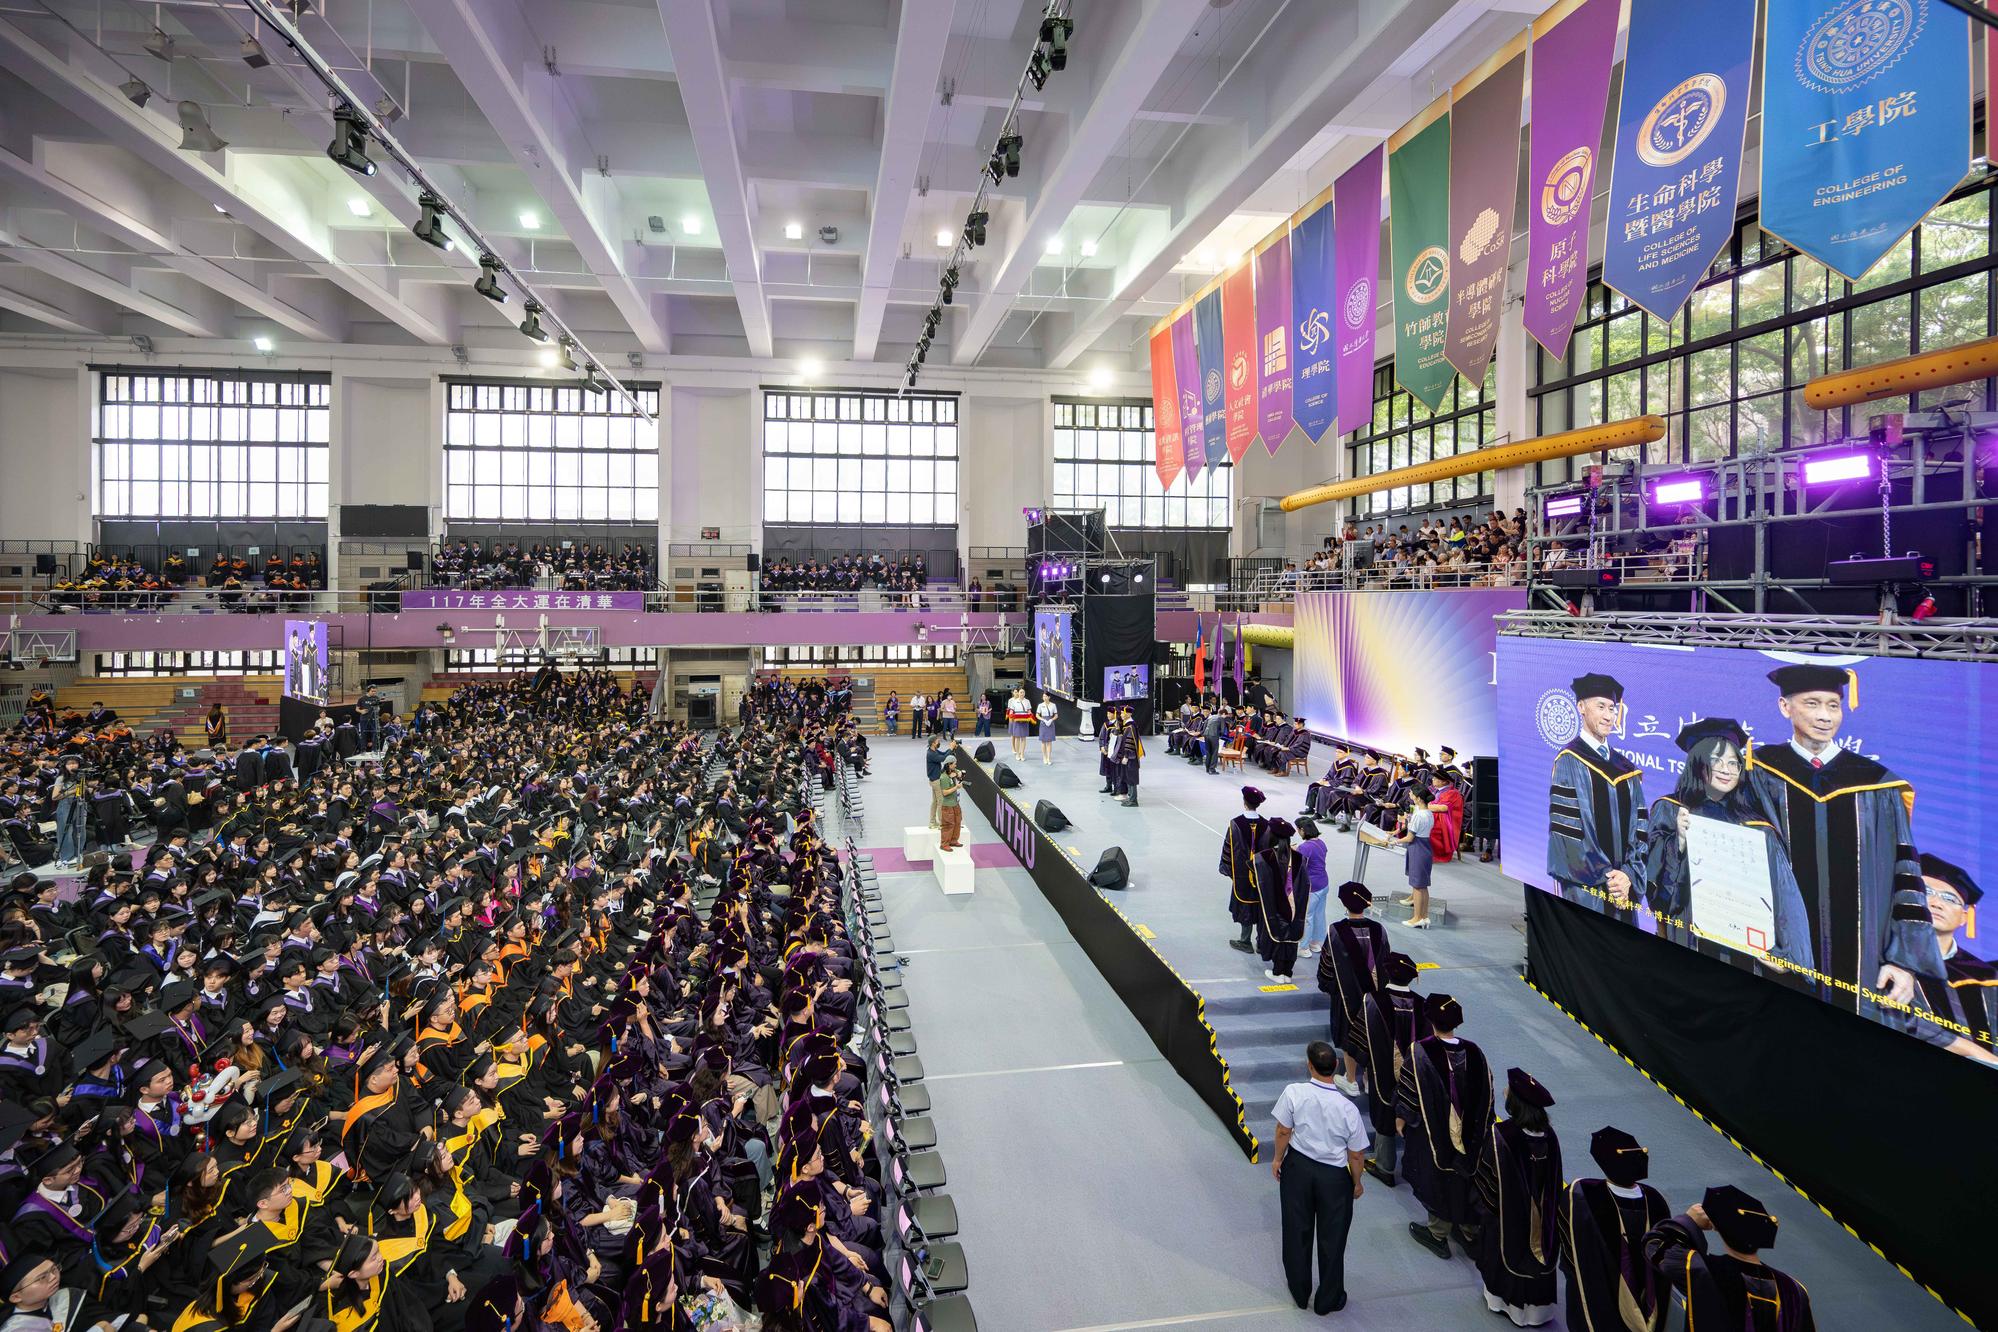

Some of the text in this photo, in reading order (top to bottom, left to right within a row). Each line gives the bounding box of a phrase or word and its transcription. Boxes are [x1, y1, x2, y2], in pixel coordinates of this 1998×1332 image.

[1816, 19, 1903, 76] TSING HUA UNIVERSITY
[1805, 91, 1918, 147] 工學院
[1626, 157, 1724, 216] 生命科學
[1812, 175, 1908, 207] ENGINEERING
[1816, 164, 1904, 196] COLLEGE OF
[1623, 185, 1722, 243] 暨醫學院
[1638, 233, 1701, 263] LIFE SCIENCES
[1643, 225, 1698, 252] COLLEGE OF
[1638, 243, 1700, 272] AND MEDICINE
[1545, 285, 1568, 300] COLLE
[1419, 329, 1445, 350] 學院
[1301, 359, 1330, 380] 理學院
[430, 594, 613, 609] 117年全大運在清華
[995, 793, 1036, 870] NTHU
[1765, 951, 1832, 987] Engineering
[1835, 976, 1859, 995] and
[1862, 987, 1911, 1014] System
[1914, 1007, 1972, 1036] Science
[1976, 1030, 1998, 1047] 王
